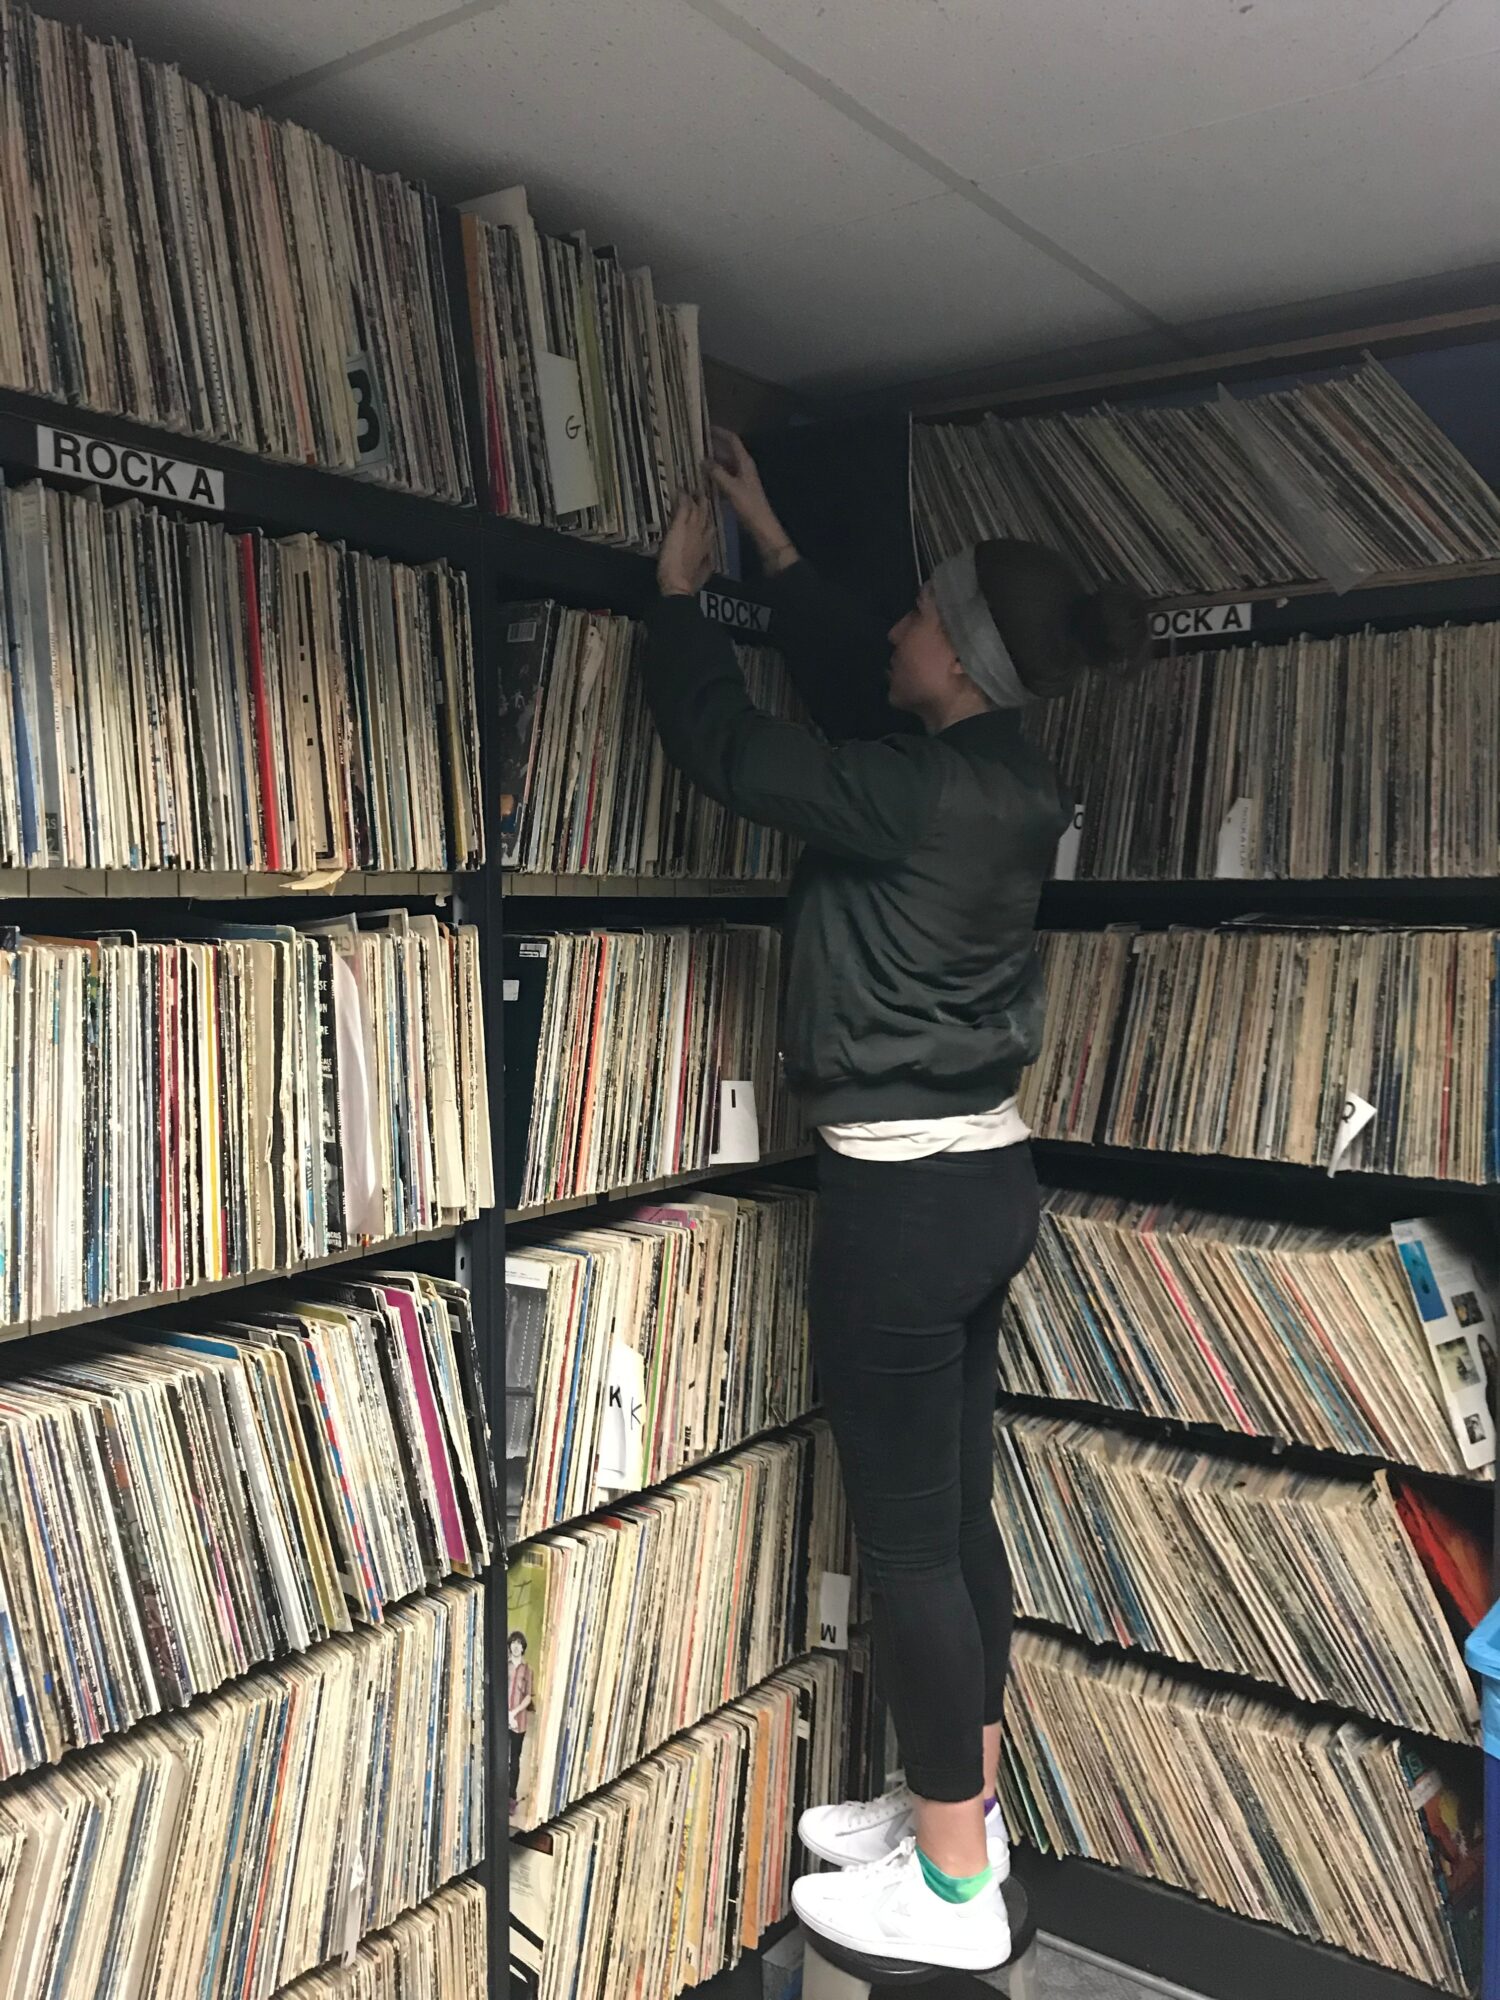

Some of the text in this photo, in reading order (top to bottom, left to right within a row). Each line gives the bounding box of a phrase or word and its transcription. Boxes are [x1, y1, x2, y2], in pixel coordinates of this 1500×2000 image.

[565, 414, 582, 440] G
[53, 430, 215, 505] ROCK A
[706, 593, 762, 630] ROCK
[1151, 605, 1243, 636] OCK A
[609, 1385, 621, 1408] K
[630, 1396, 642, 1430] K
